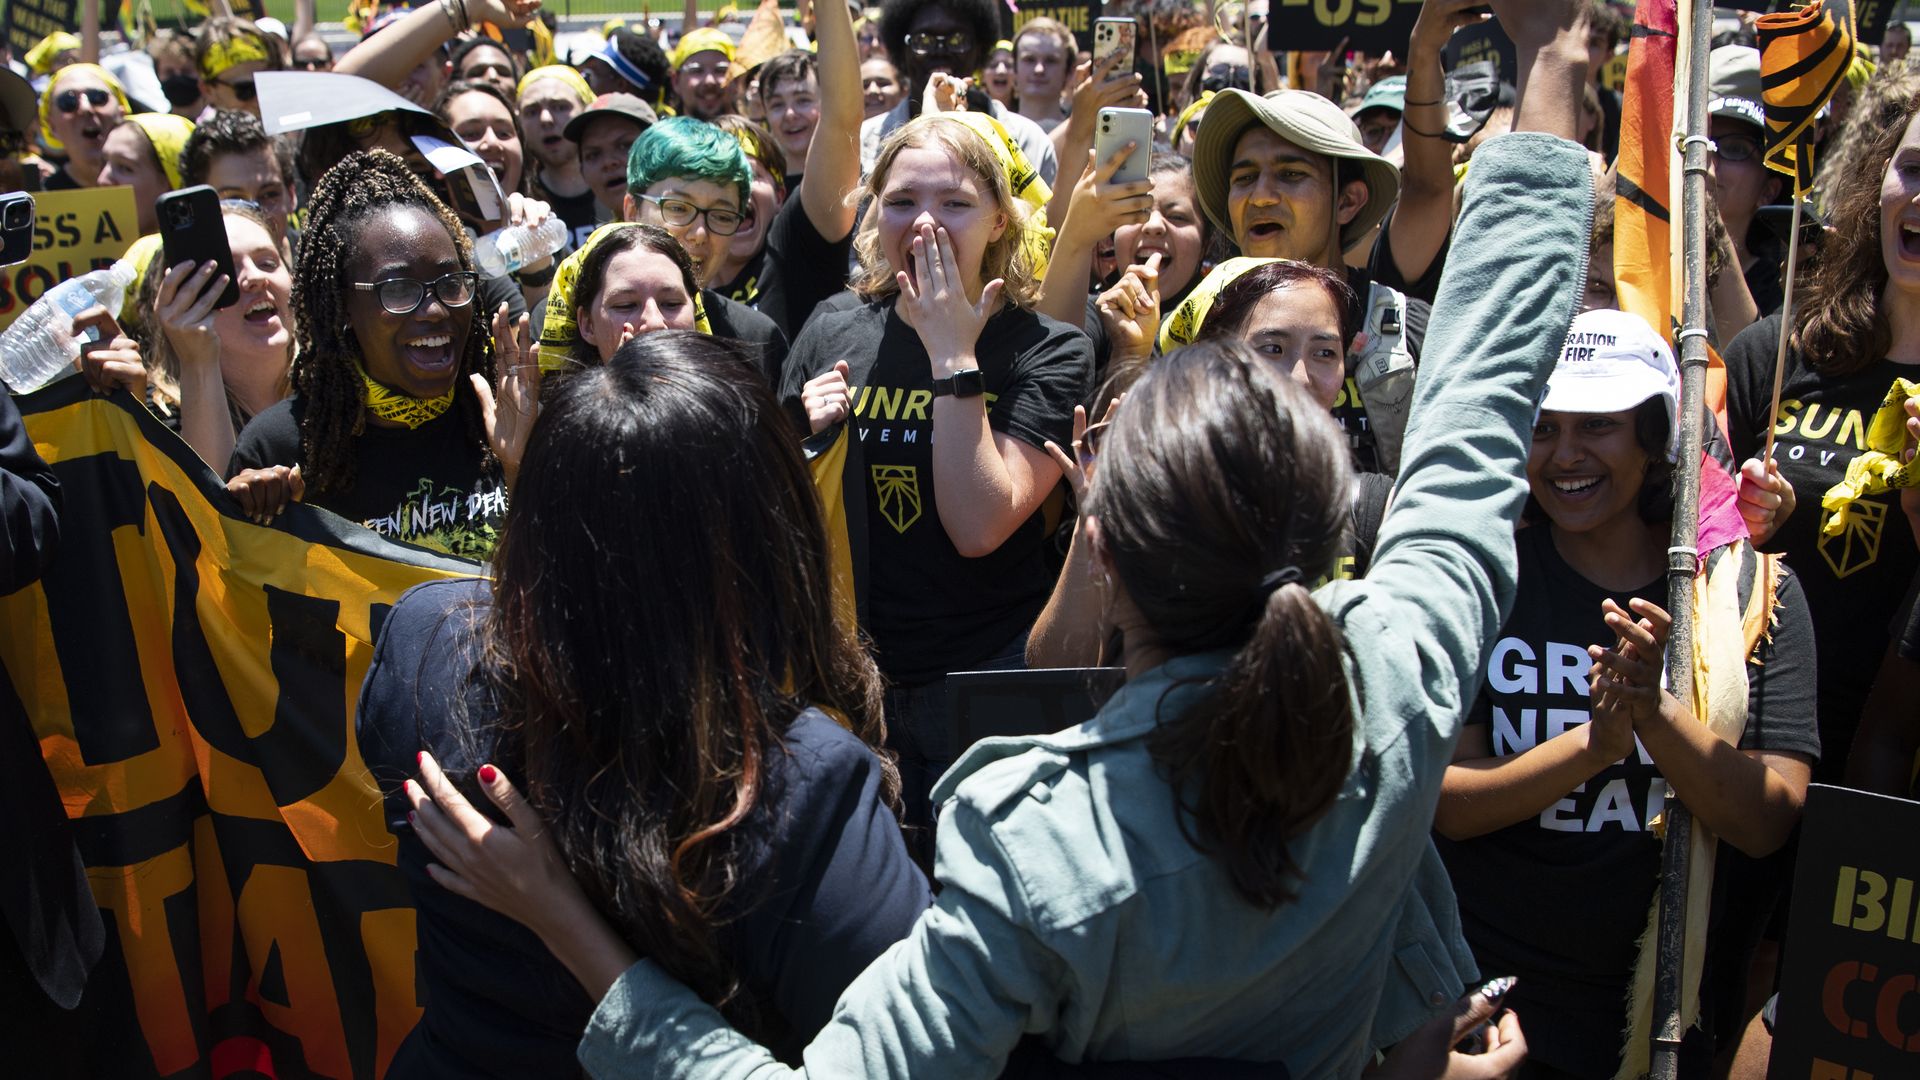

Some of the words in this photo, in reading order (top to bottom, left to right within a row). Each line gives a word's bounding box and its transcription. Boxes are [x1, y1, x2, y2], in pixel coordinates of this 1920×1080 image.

[94, 210, 123, 244] A
[1564, 347, 1596, 362] FIRE
[858, 427, 934, 444] VEM
[412, 493, 458, 536] NEW
[1832, 865, 1920, 945] BI
